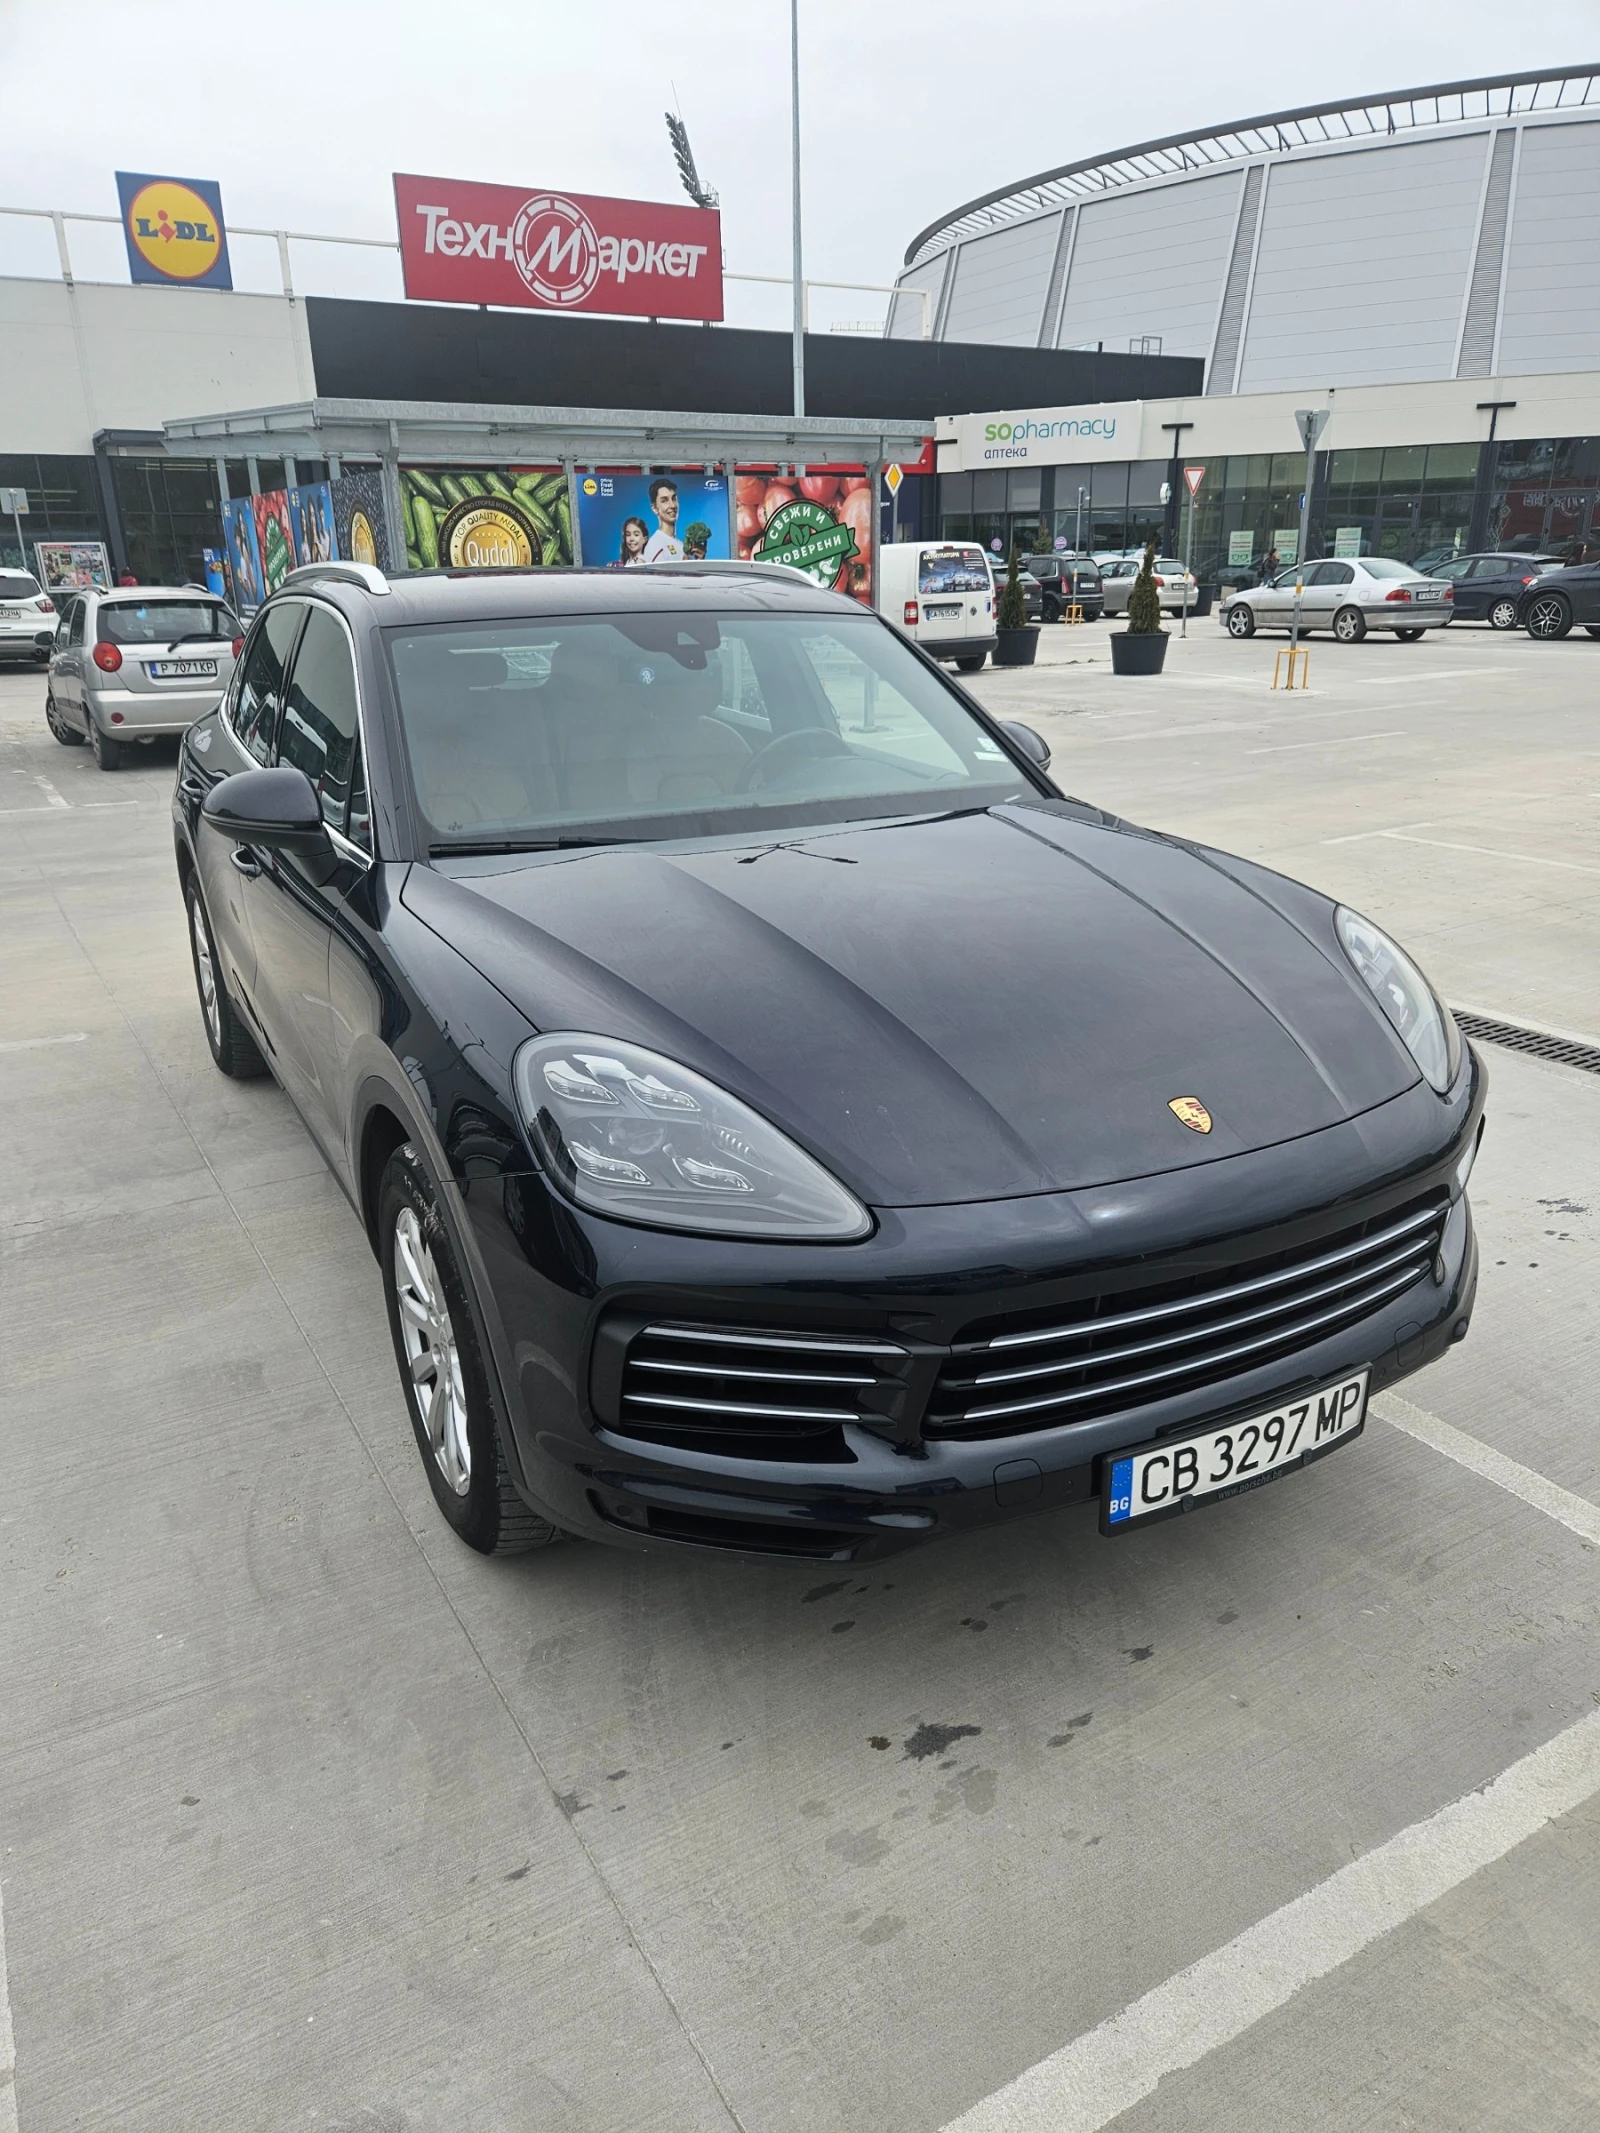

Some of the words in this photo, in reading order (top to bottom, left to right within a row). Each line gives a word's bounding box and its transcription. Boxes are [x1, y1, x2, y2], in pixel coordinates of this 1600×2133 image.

[984, 418, 1116, 445] sopharmacy
[984, 447, 1028, 459] аптека
[455, 522, 467, 540] TOP
[467, 511, 499, 526] QUALITY
[499, 516, 523, 541] MEDAL
[769, 506, 811, 540] СВЕЖИ
[815, 511, 826, 525] И
[161, 663, 168, 674] P
[173, 662, 199, 674] 7071
[200, 662, 214, 673] KP
[1141, 1445, 1200, 1505] CB
[1210, 1402, 1310, 1483] 3297
[1314, 1381, 1361, 1442] MP
[1217, 1468, 1284, 1500] www.porsche.bg
[1109, 1496, 1130, 1515] BG
